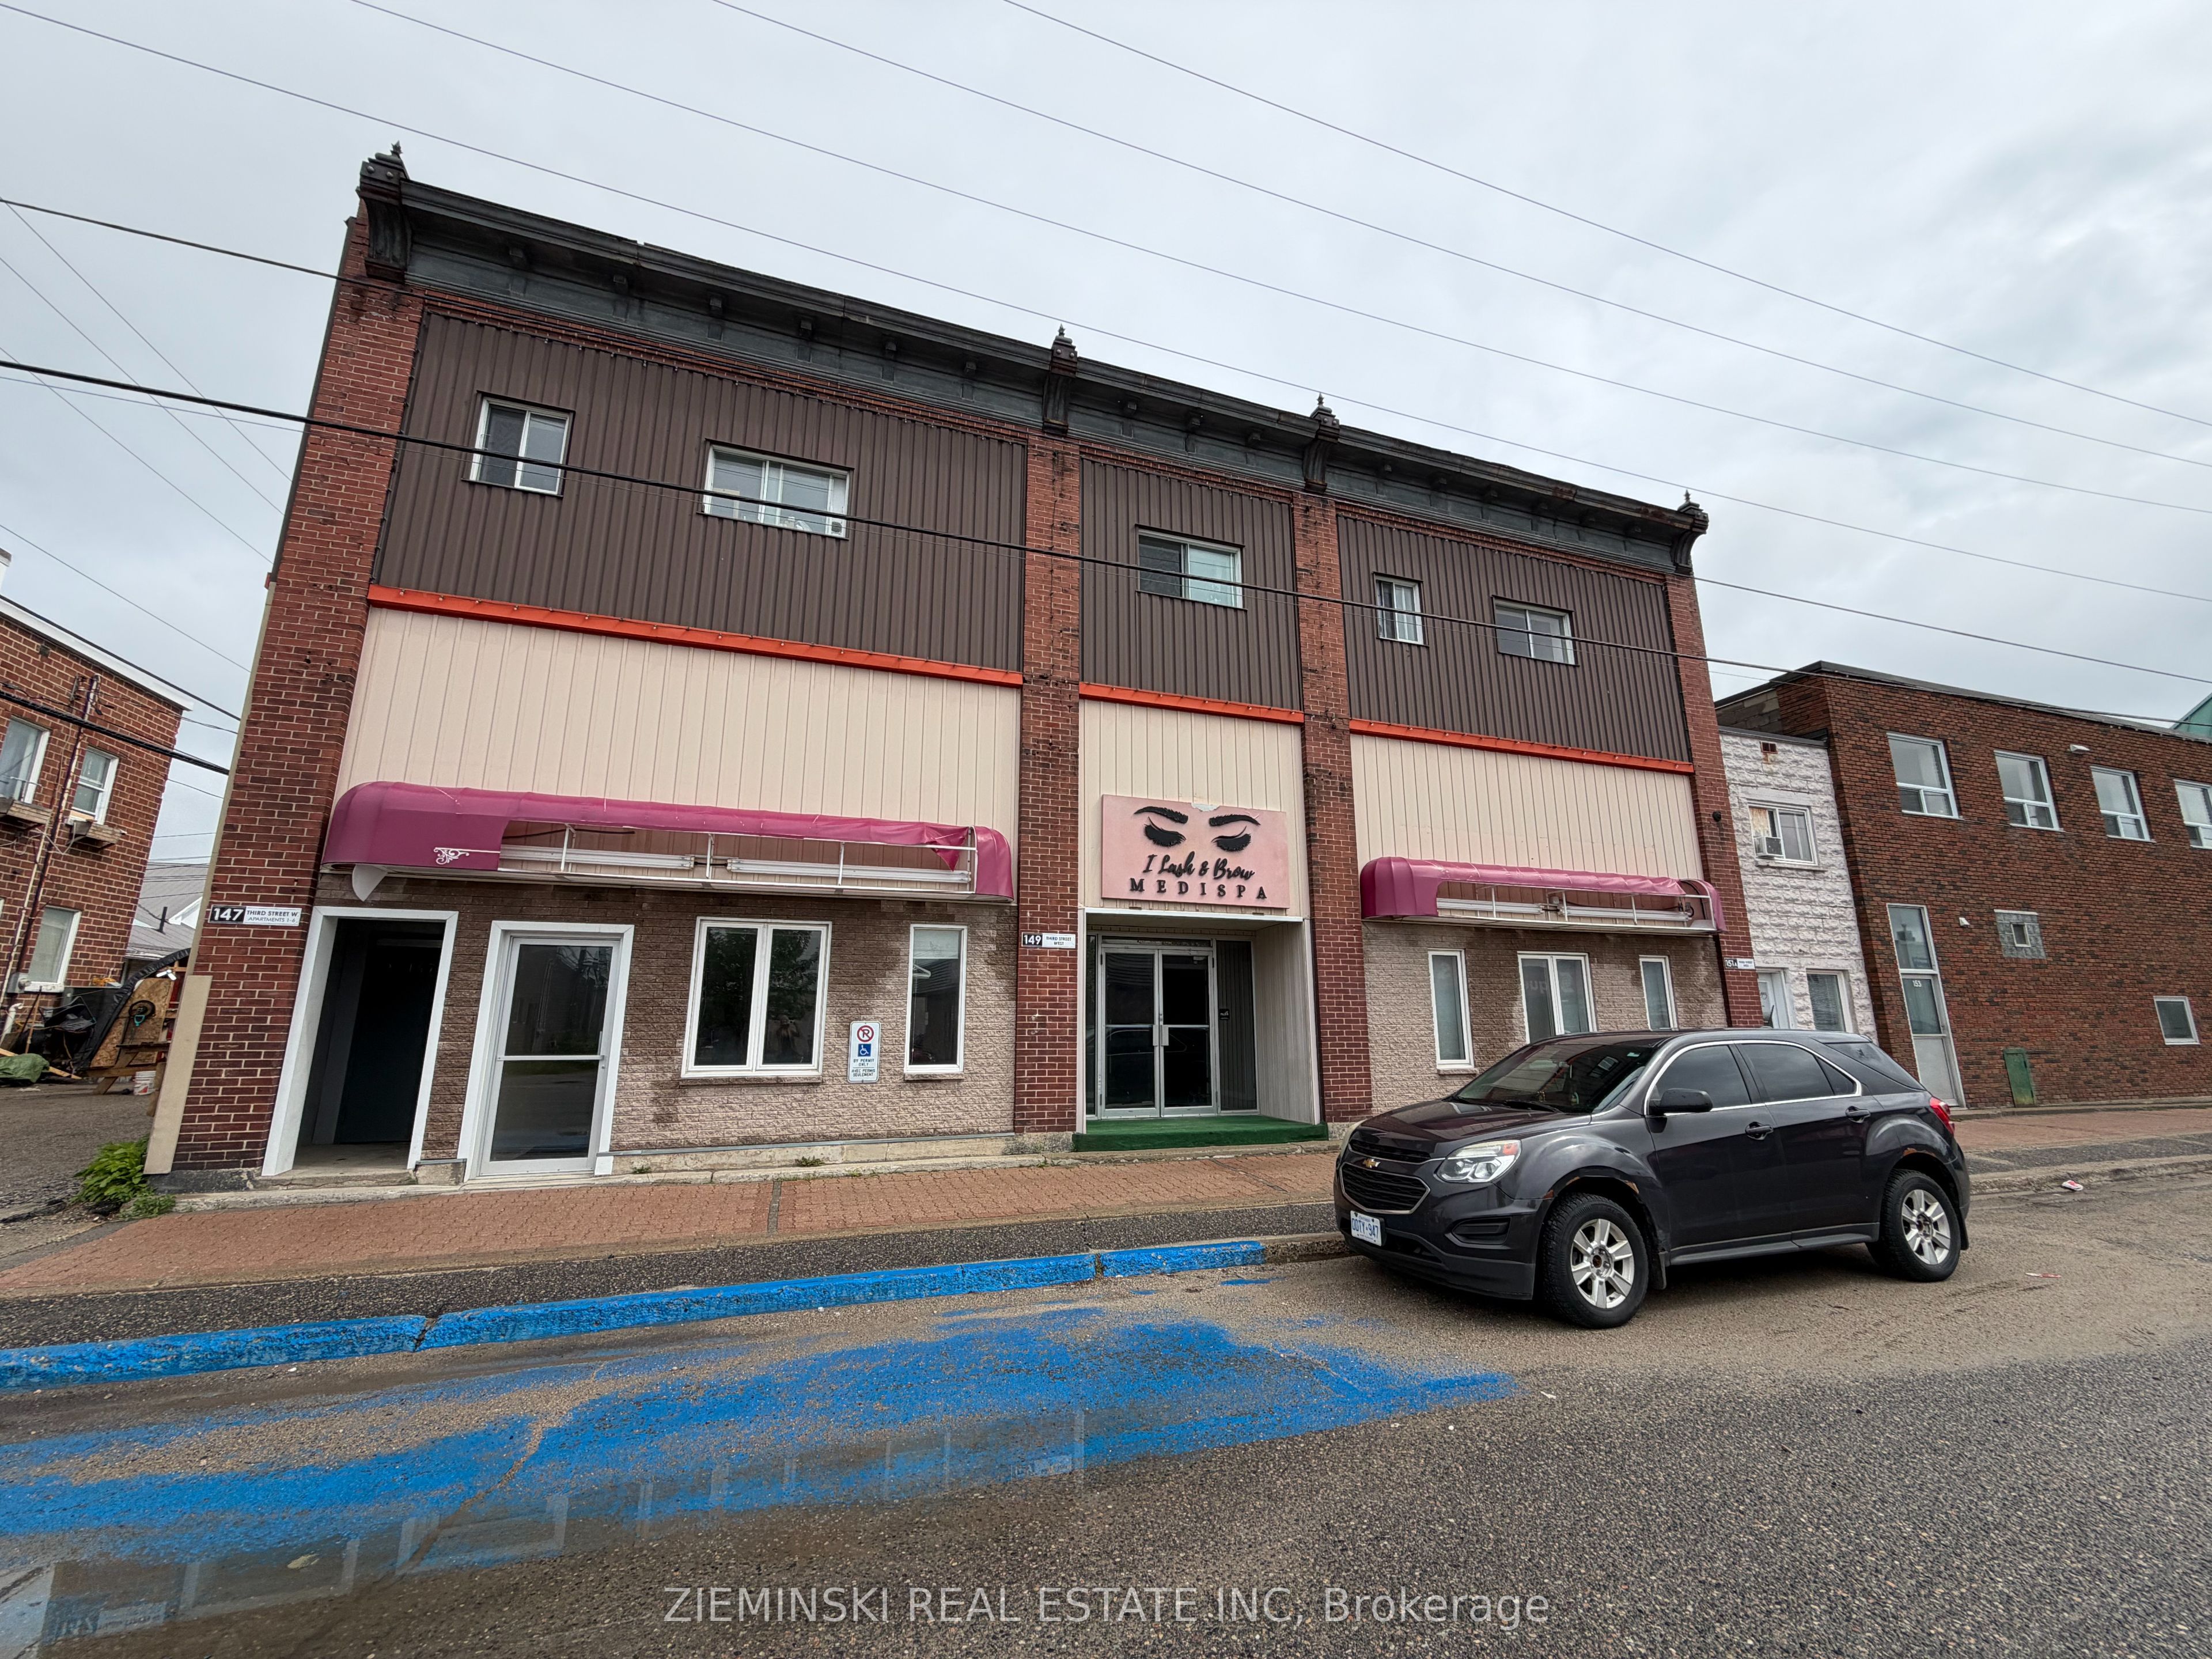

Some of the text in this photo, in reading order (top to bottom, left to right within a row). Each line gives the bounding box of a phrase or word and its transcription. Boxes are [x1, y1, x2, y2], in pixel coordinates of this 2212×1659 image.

[1143, 851, 1255, 880] I Lash & Brow
[1130, 878, 1267, 900] MEDISPA
[213, 908, 244, 921] 147
[1024, 934, 1041, 945] 149
